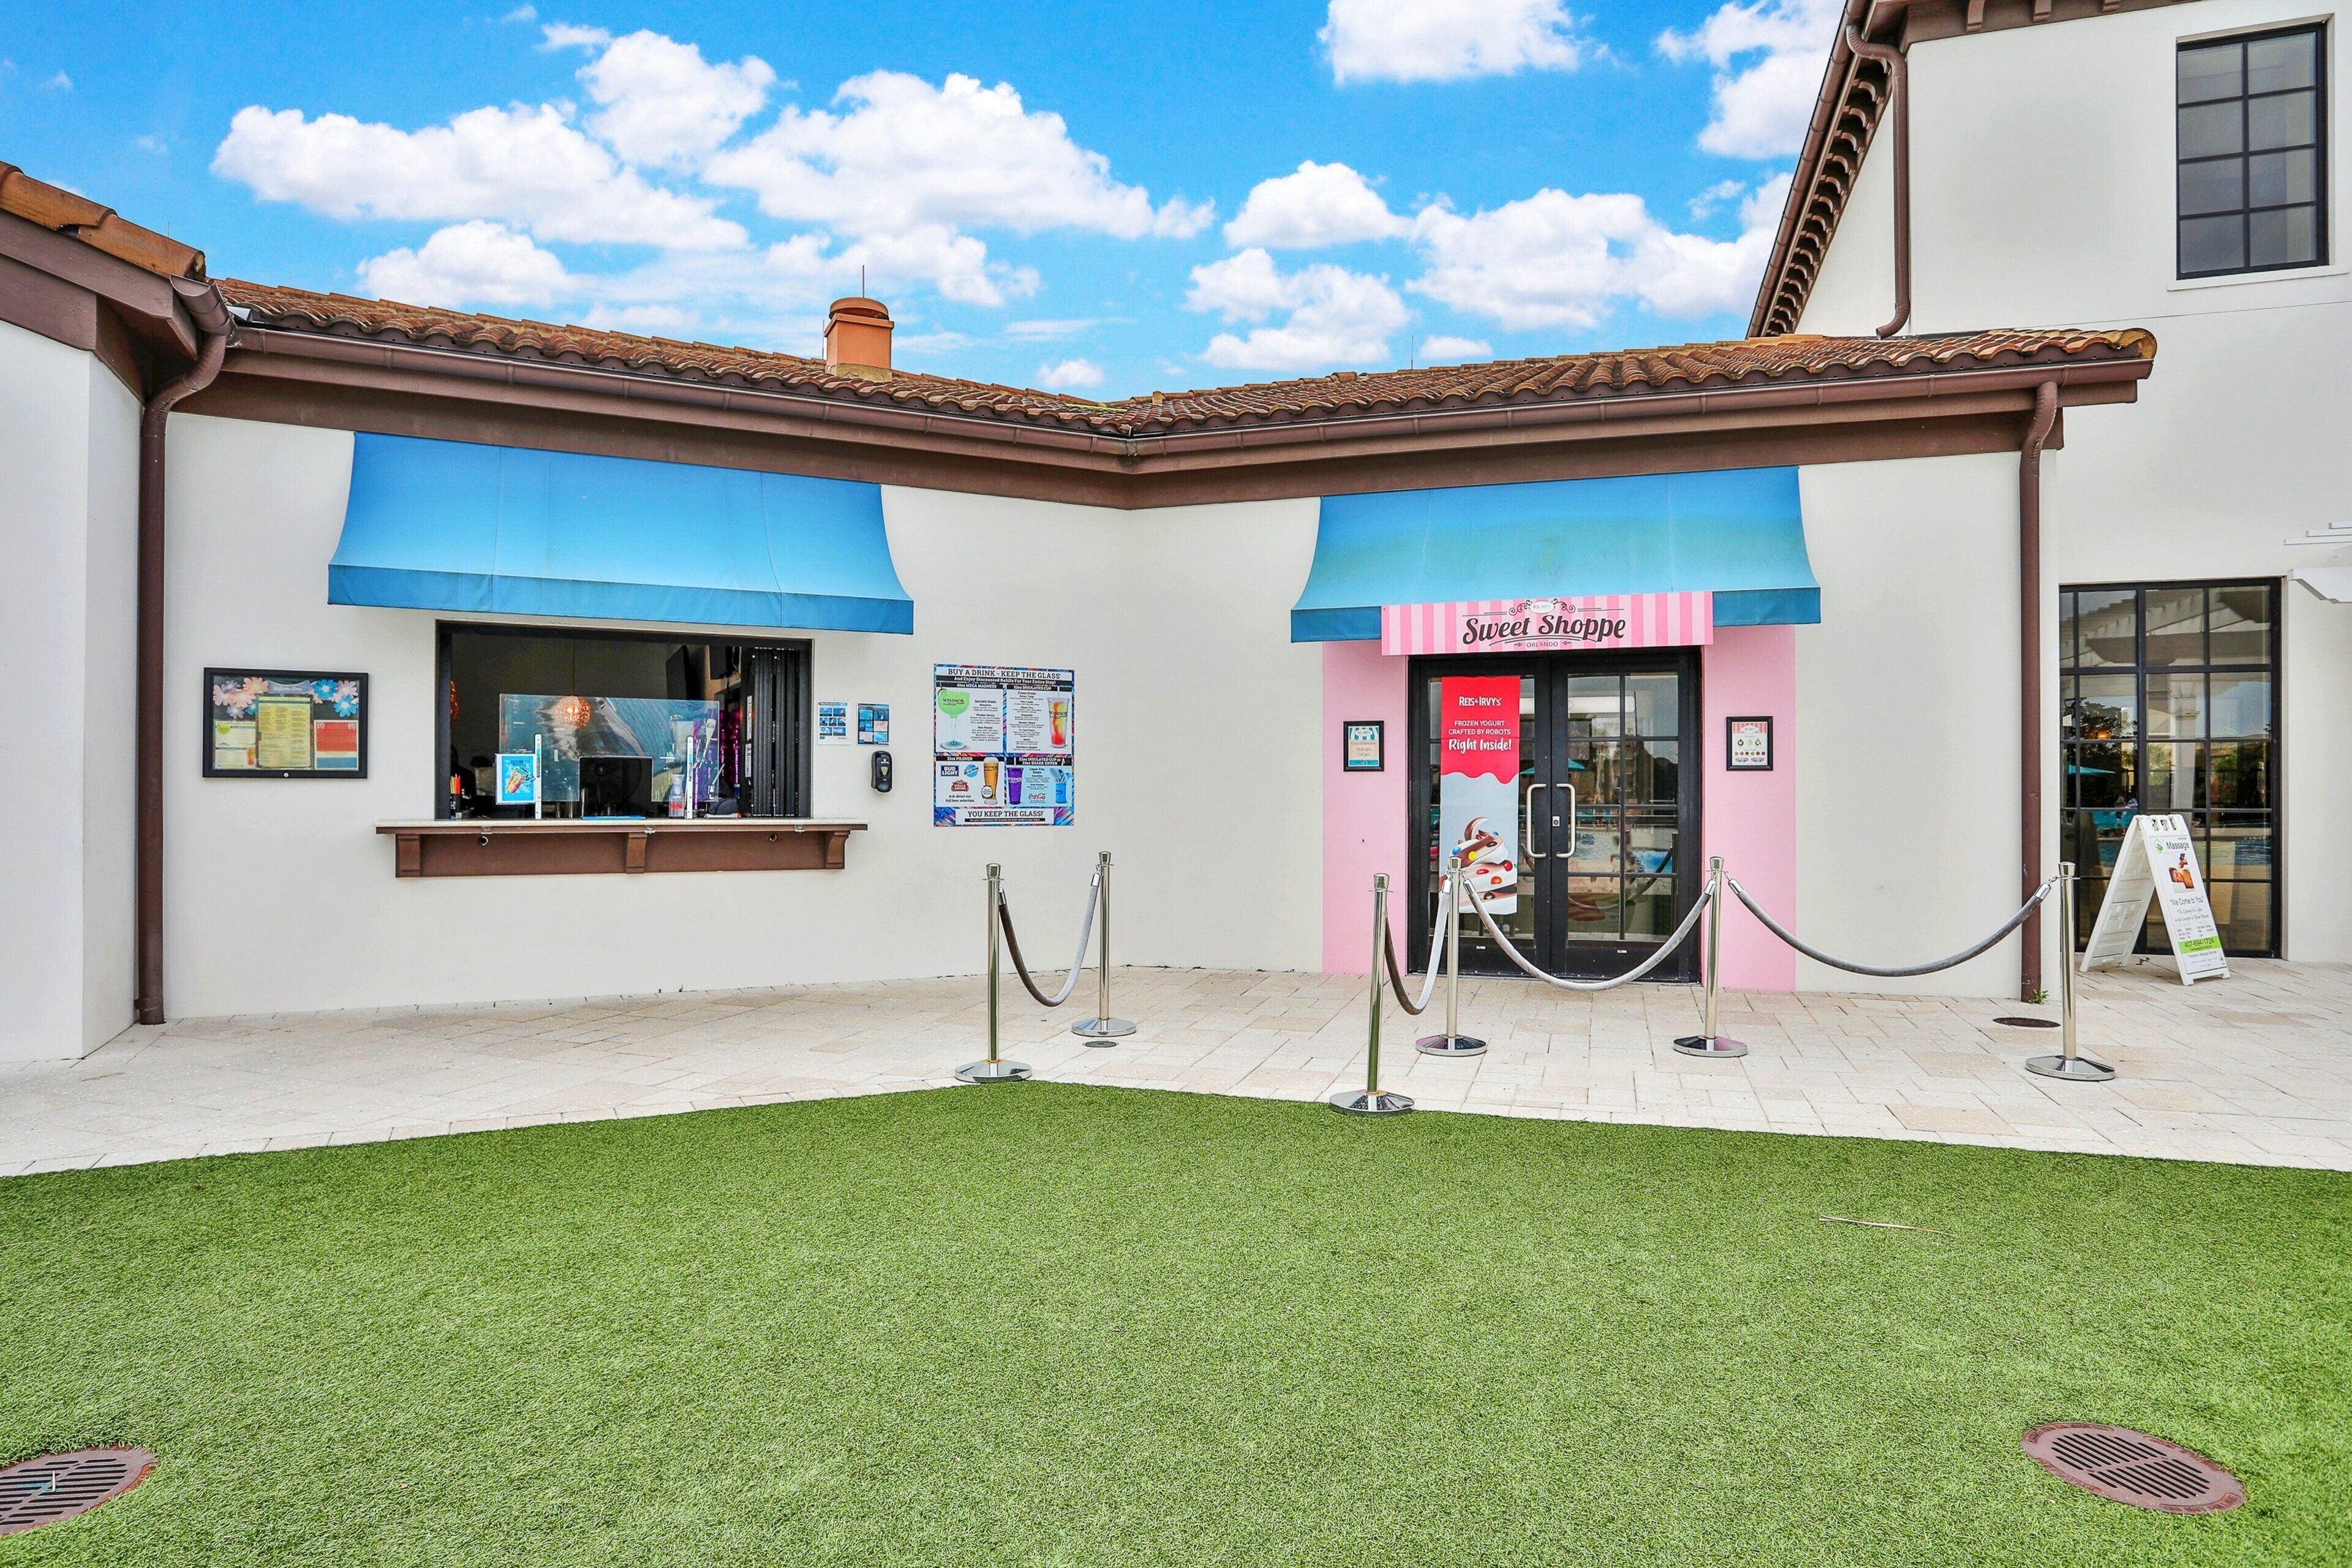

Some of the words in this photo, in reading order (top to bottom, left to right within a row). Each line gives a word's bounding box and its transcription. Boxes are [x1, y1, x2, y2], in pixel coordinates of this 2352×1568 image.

[1463, 617, 1531, 644] Sweet
[1538, 614, 1626, 642] Shoppe
[1459, 696, 1475, 706] REIS
[1449, 737, 1477, 754] Right
[1480, 737, 1512, 751] Inside!
[2166, 842, 2189, 850] Massage
